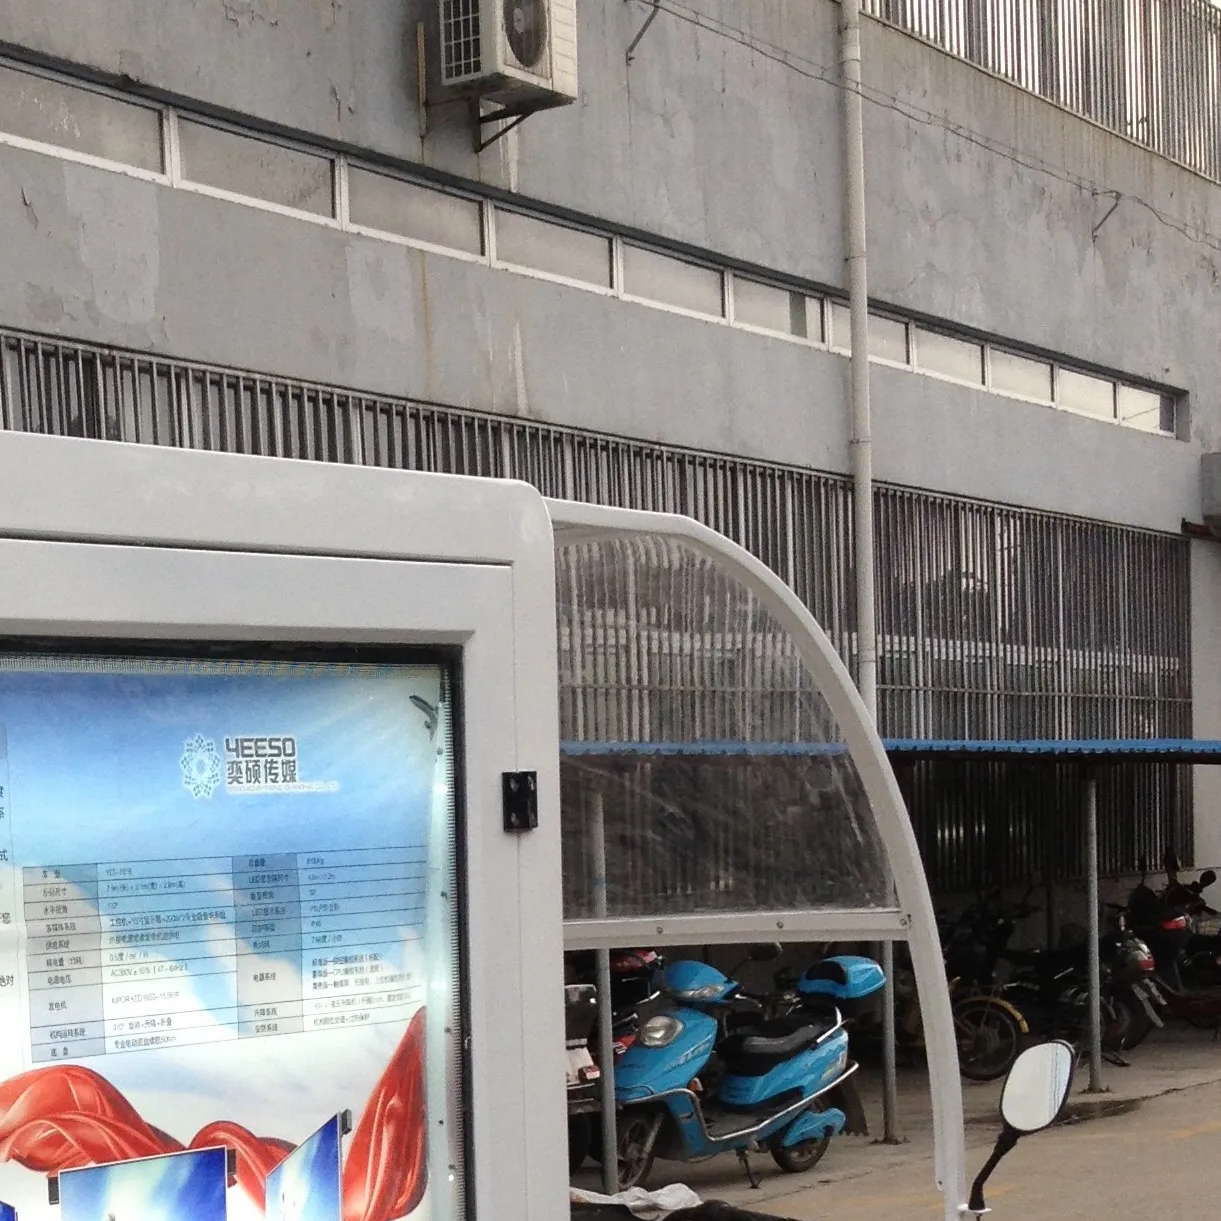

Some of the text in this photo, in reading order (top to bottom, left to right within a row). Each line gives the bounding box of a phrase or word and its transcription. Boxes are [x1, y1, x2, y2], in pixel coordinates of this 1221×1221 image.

[225, 737, 296, 758] YEESO
[227, 759, 297, 785] 奕硕传媒
